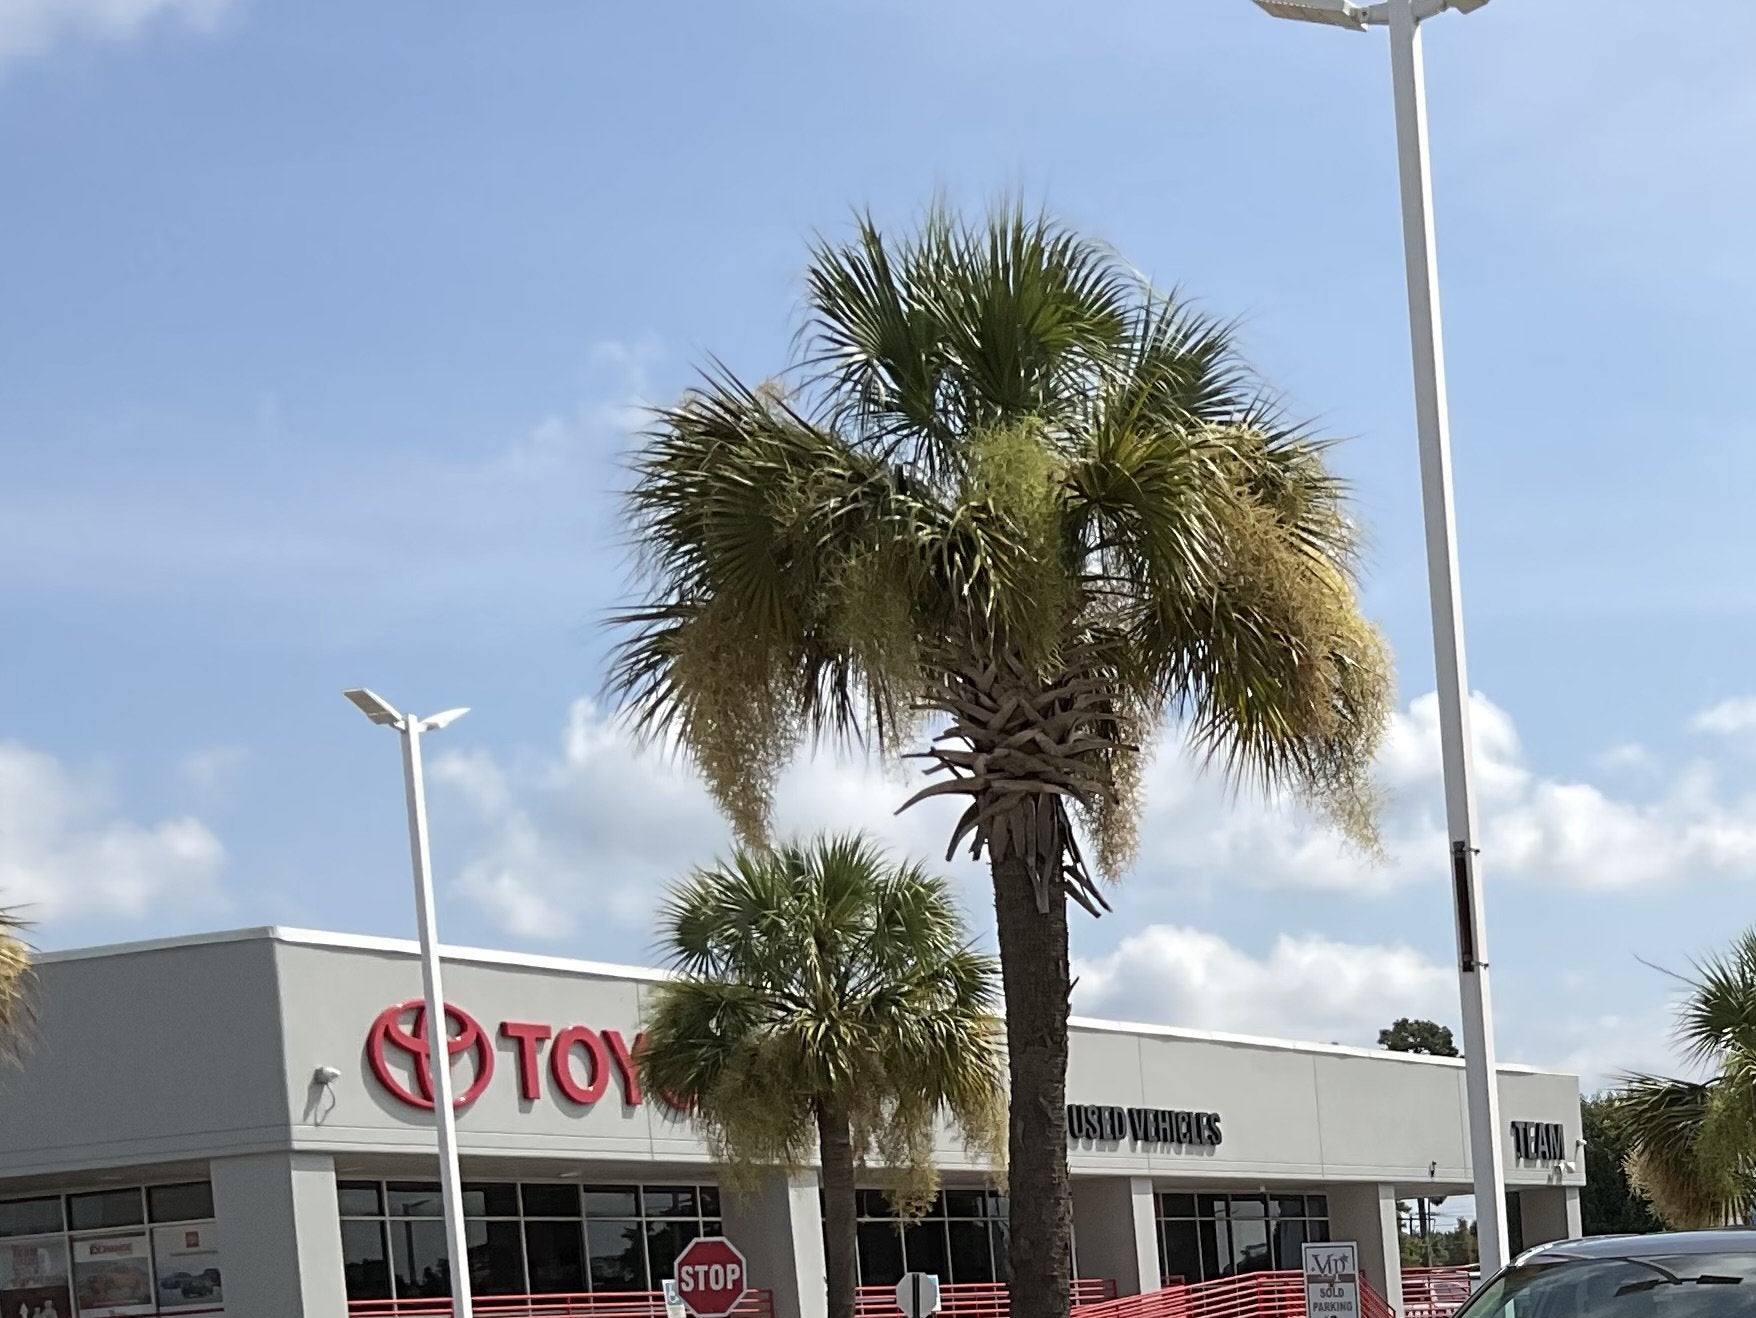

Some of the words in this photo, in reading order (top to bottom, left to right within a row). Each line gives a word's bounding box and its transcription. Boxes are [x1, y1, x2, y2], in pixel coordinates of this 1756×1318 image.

[1067, 1104, 1127, 1140] USED
[1127, 1107, 1222, 1145] VEHICLES
[1511, 1121, 1565, 1160] TEAM
[681, 1264, 740, 1292] STOP
[1312, 1301, 1353, 1312] PARKING
[1319, 1287, 1344, 1298] SOLD
